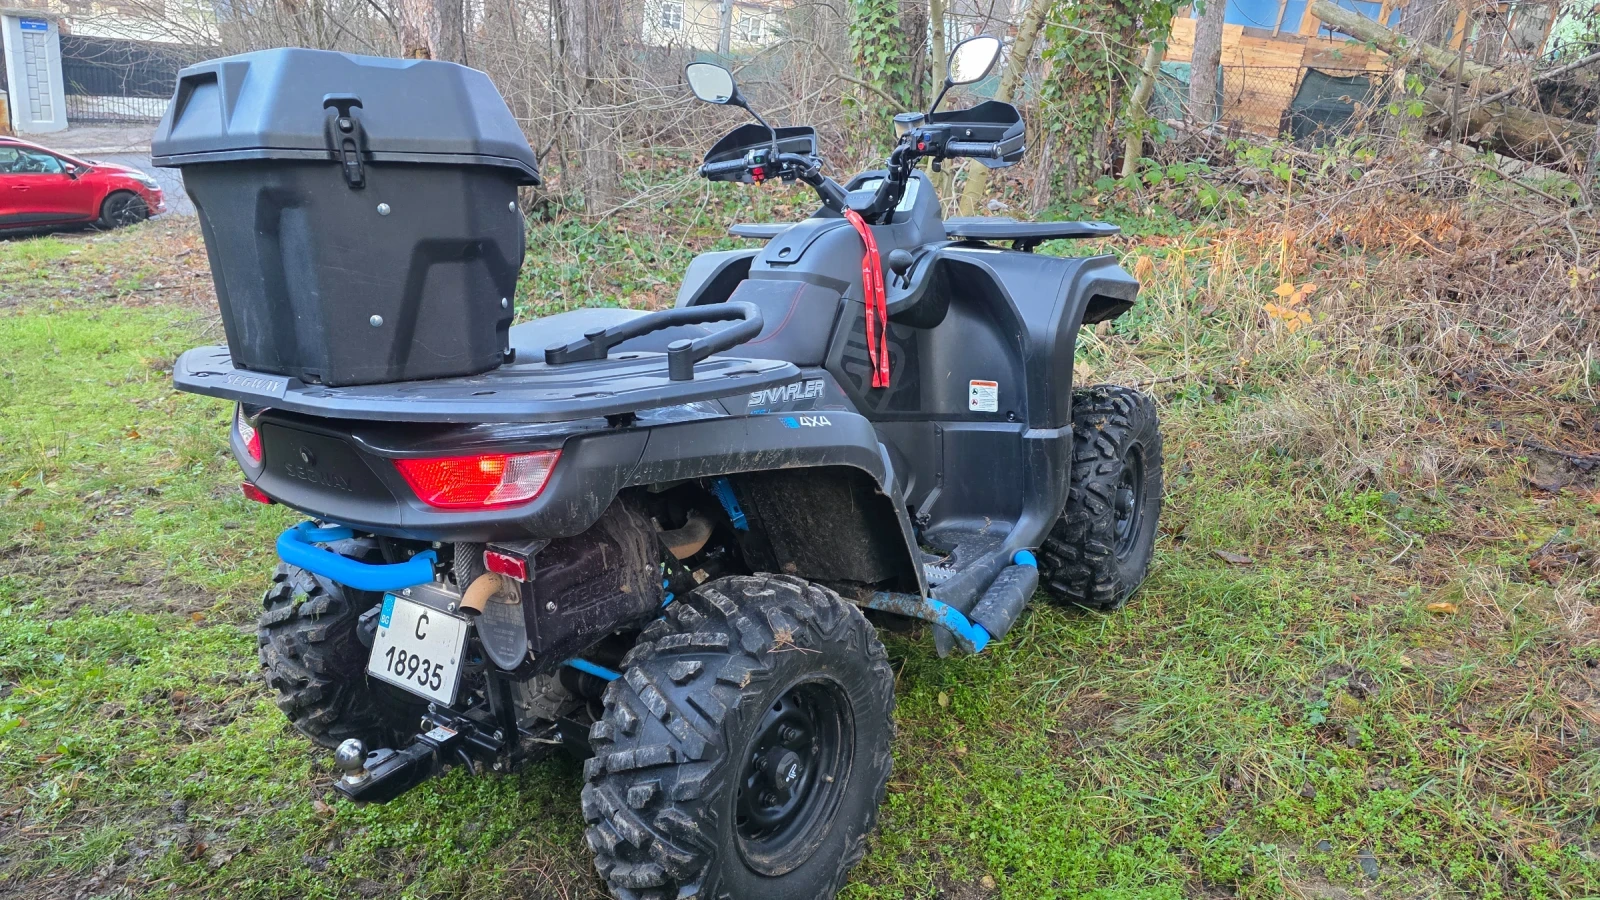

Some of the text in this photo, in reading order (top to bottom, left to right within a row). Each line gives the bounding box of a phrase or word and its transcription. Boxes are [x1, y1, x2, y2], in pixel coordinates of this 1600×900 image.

[223, 373, 283, 392] SEGWAY
[747, 379, 825, 407] SNARLER
[799, 415, 832, 428] 4X4
[380, 614, 390, 625] BG
[385, 646, 444, 691] 18935
